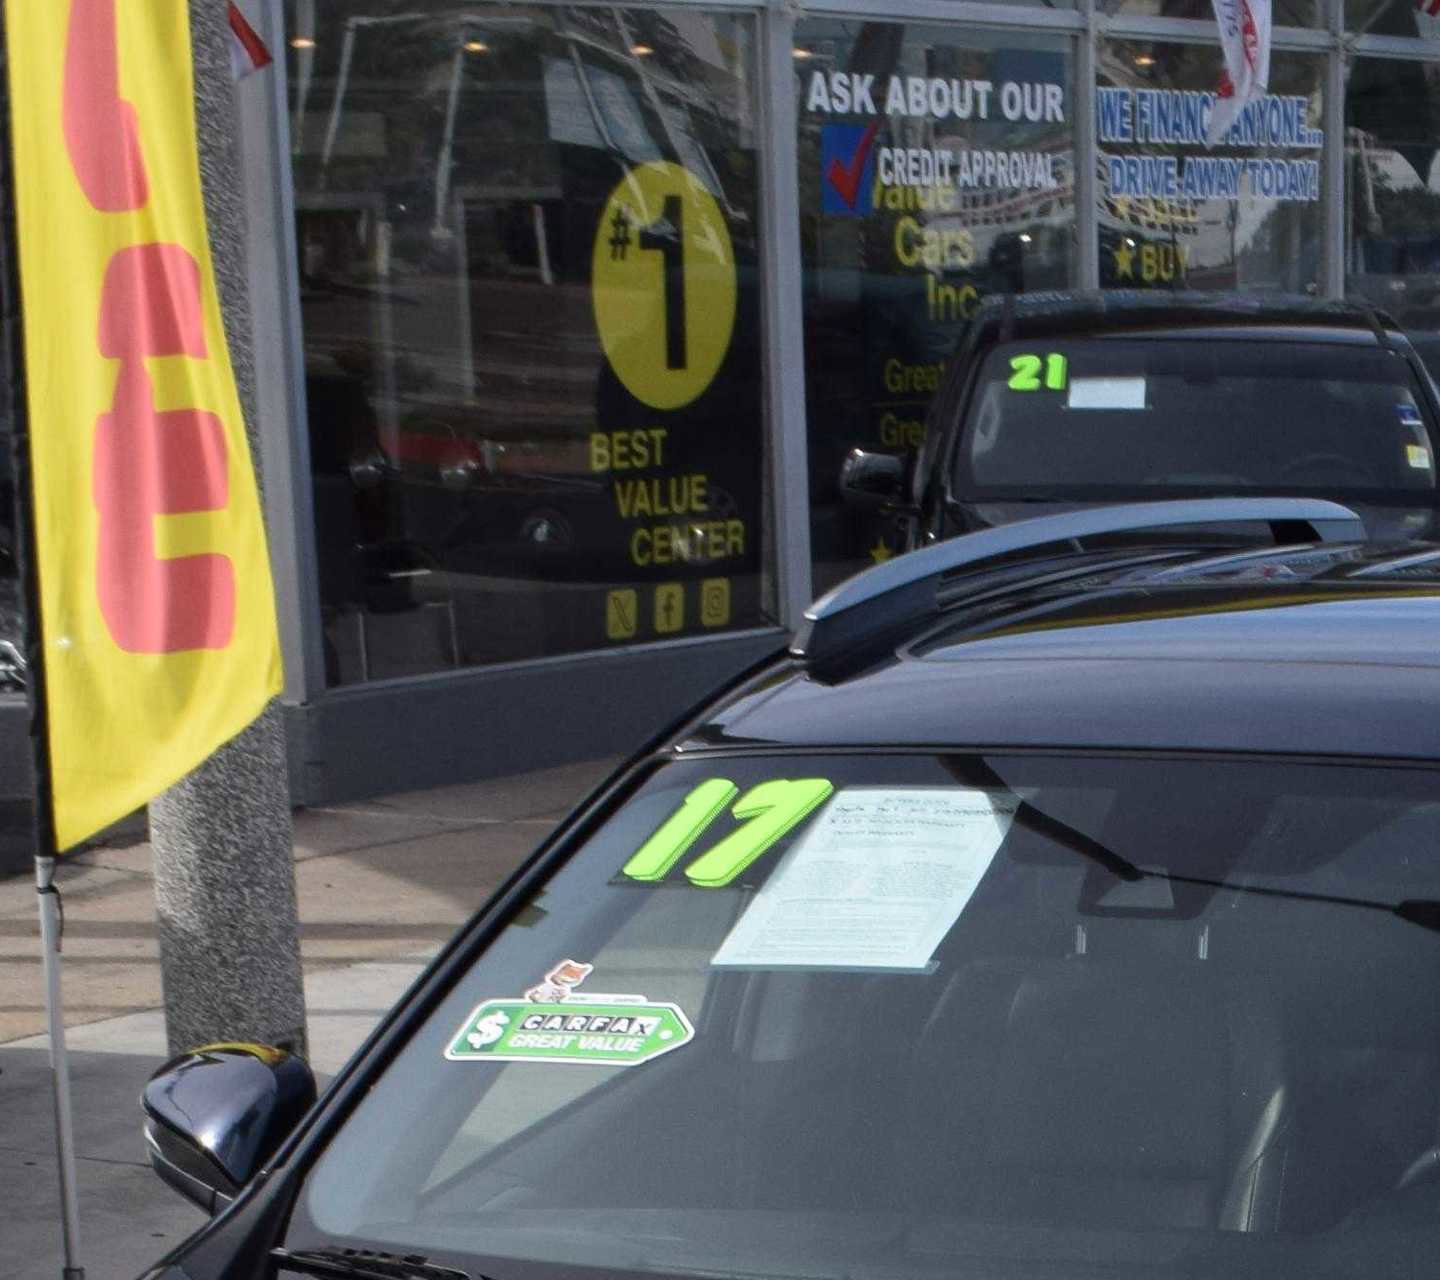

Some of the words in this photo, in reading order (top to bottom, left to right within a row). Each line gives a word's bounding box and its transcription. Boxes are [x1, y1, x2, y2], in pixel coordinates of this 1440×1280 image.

[806, 70, 877, 115] ASK
[884, 75, 993, 120] ABOUT
[1000, 82, 1065, 123] OUR
[1096, 87, 1132, 143] WE
[1136, 88, 1218, 145] FINANC
[878, 146, 954, 187] CREDIT
[959, 148, 1059, 188] APPROVAL
[1110, 156, 1177, 199] DRIVE
[1183, 157, 1243, 200] AWAY
[1247, 159, 1320, 201] TODAY!
[895, 215, 977, 269] Cars
[1141, 243, 1191, 281] BUY
[609, 195, 688, 370] #1
[884, 358, 945, 394] Grea
[1008, 352, 1068, 392] 21
[590, 429, 667, 471] BEST
[880, 414, 928, 448] Gre
[614, 474, 708, 517] VALUE
[630, 520, 745, 566] CENTER
[620, 777, 836, 889] 17
[509, 1034, 576, 1050] GREAT
[577, 1034, 645, 1052] VALUE
[521, 1014, 653, 1036] CARFAX
